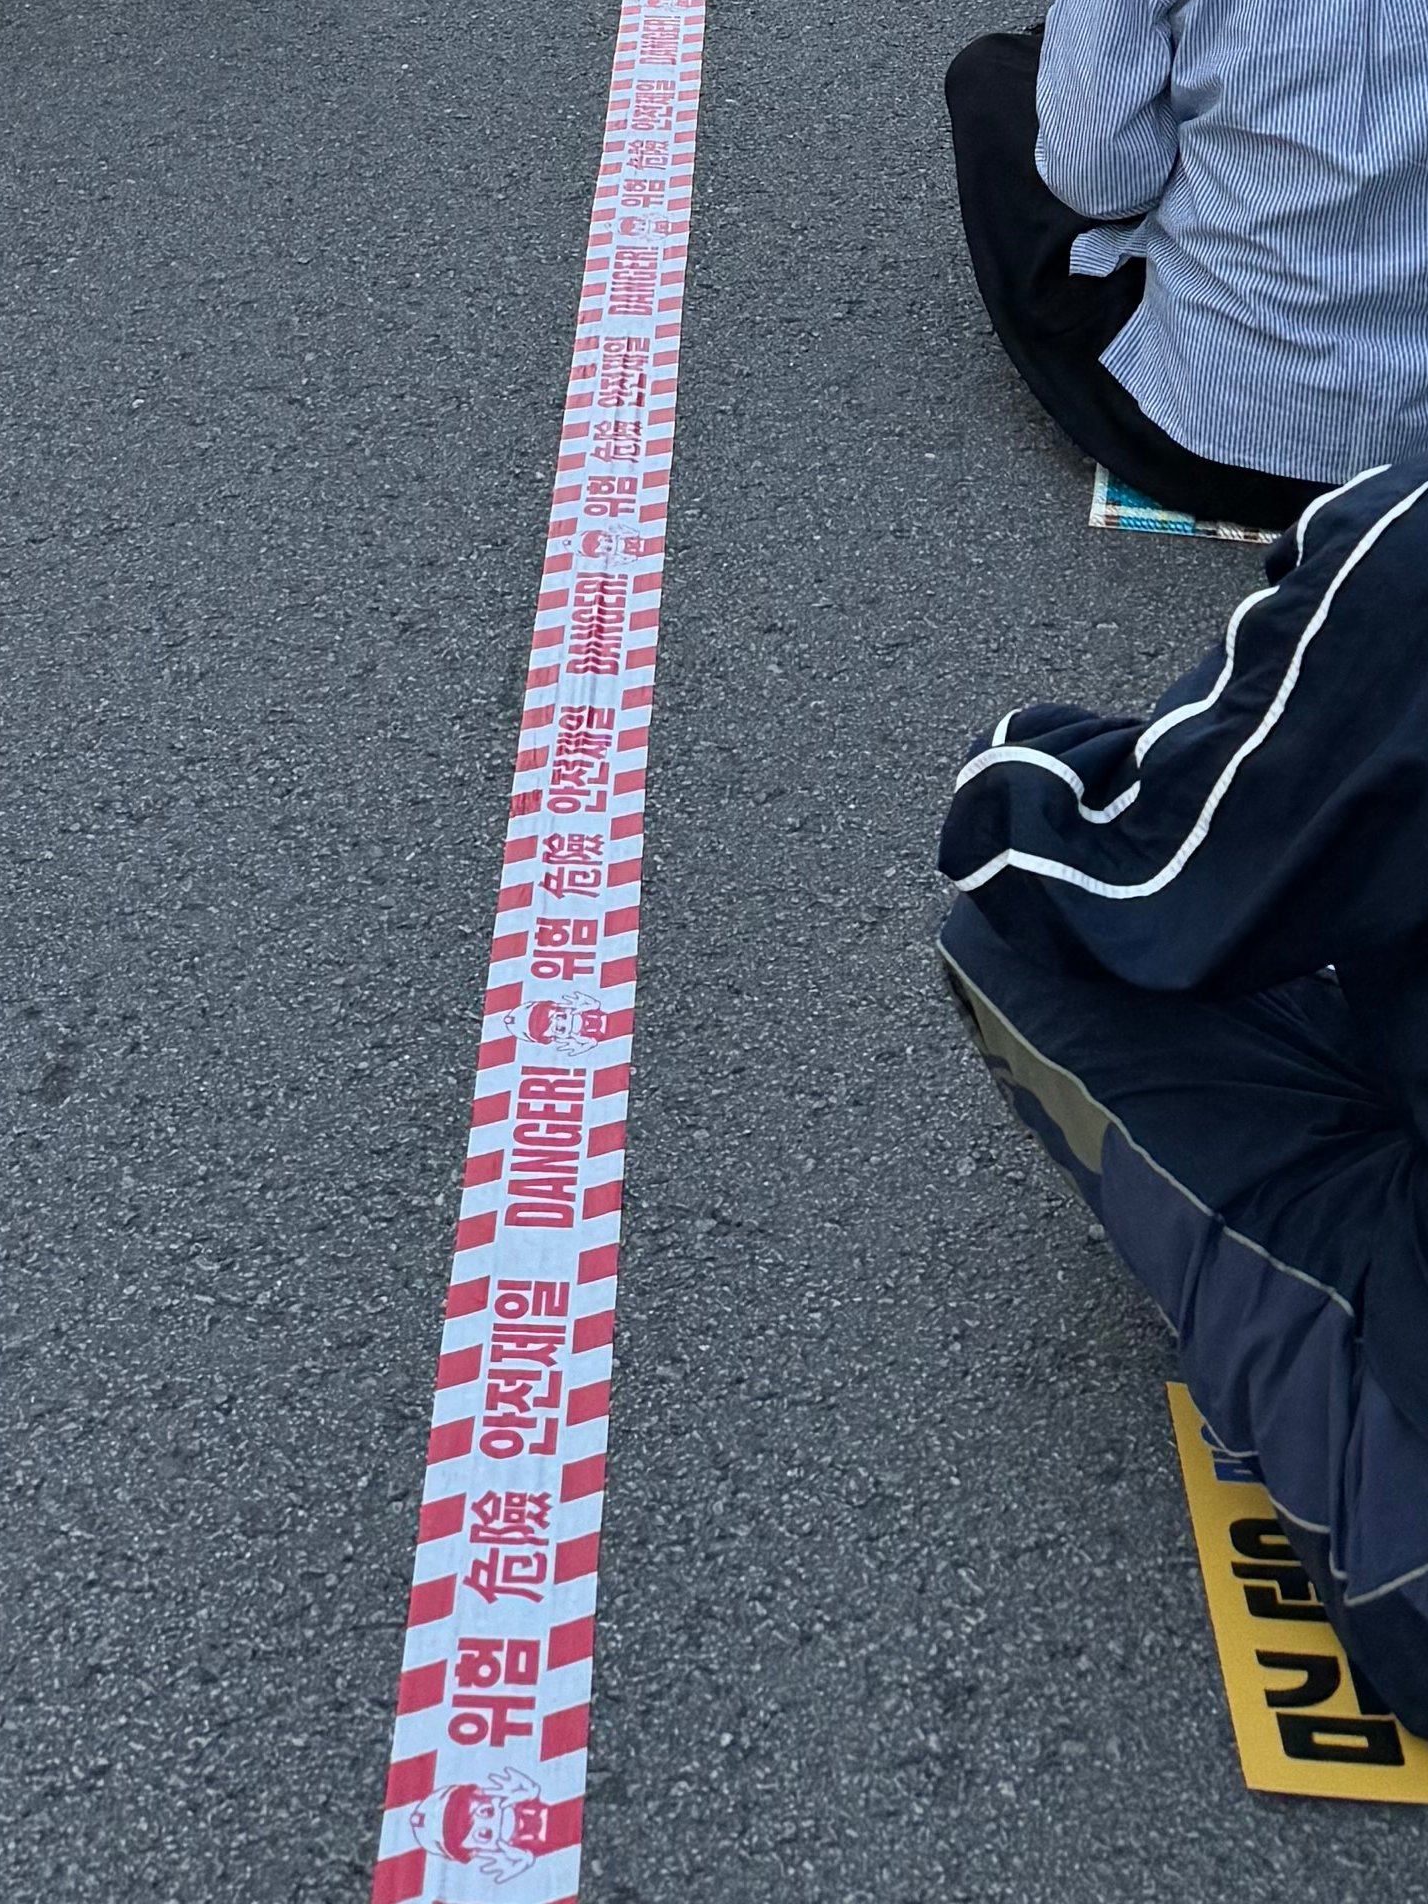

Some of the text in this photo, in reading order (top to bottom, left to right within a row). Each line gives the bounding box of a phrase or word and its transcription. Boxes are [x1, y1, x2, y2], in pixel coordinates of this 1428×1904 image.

[639, 14, 681, 66] DANGER!
[632, 80, 676, 132] 안전제일
[621, 178, 668, 210] 위험
[608, 246, 661, 318] DANGER!
[599, 333, 651, 409] 안전제일
[590, 418, 644, 466] 危險
[583, 474, 639, 519] 위험
[565, 572, 627, 676] DANGER!
[547, 704, 616, 814] 안전제일
[537, 833, 606, 899] 危險
[529, 917, 599, 981] 위험
[504, 1065, 588, 1229] DANGER!
[478, 1279, 570, 1460] 안전제일
[462, 1489, 553, 1604] 危險
[447, 1637, 541, 1748] 위험
